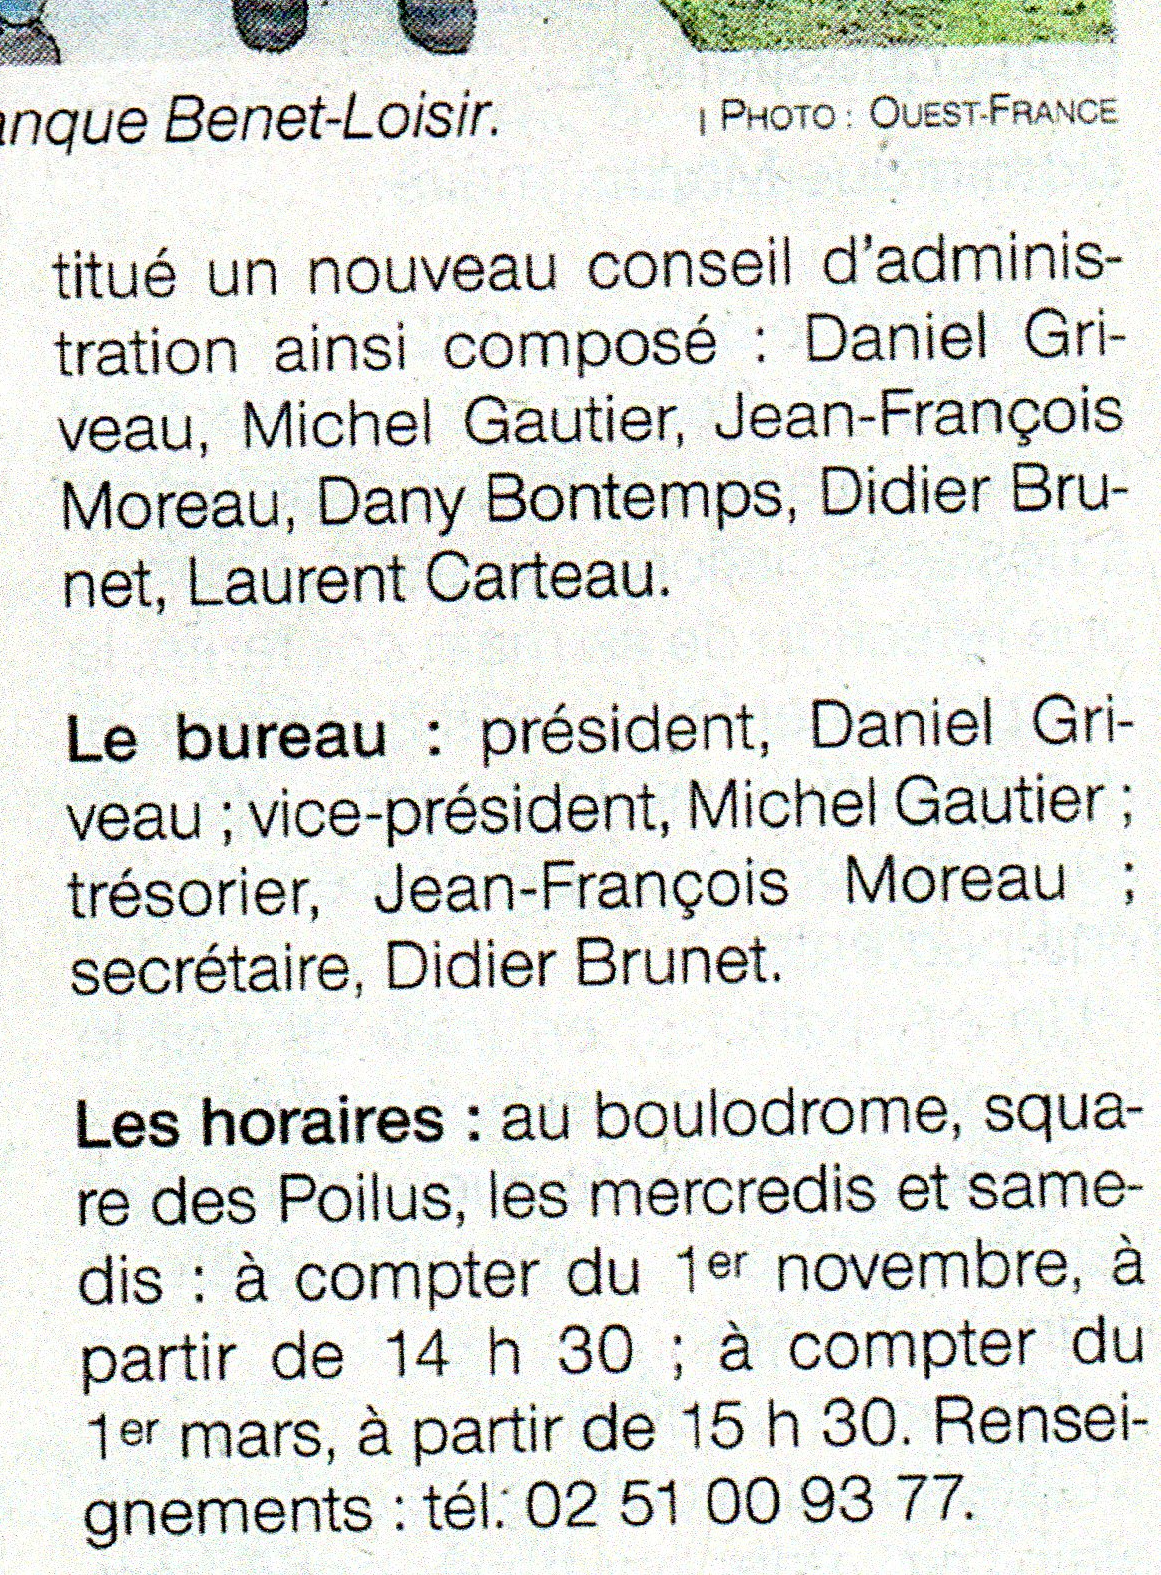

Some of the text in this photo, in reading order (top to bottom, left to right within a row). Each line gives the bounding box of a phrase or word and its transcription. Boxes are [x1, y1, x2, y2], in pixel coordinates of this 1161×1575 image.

[164, 89, 498, 144] Benet-Loisir.
[721, 92, 1120, 131] PHOTO OUEST-FRANCE
[52, 236, 791, 300] titué nouveau conseil
[54, 306, 1125, 379] tration ainsi composé Daniel Gri-
[58, 384, 1123, 458] veau, Michel Gautier, Jean-François
[62, 461, 1128, 537] Moreau, Dany Bontemps, Didier Bru-
[64, 549, 670, 615] net, Laurent Carteau.
[67, 692, 1134, 768] Le bureau président, Daniel Gri-
[66, 773, 1105, 848] veau vice-président, Michel Gautier
[67, 853, 1065, 921] trésorier, Jean-François Moreau
[71, 936, 781, 997] secrétaire, Didier Brunet.
[76, 1086, 1143, 1150] Les horaires boulodrome, squa-
[151, 1163, 1143, 1227] des Poilus, mercredis same-
[295, 1251, 540, 1311] compter
[778, 1238, 1081, 1293] novembre,
[82, 1320, 1036, 1396] partir 14 30 compter
[181, 1419, 335, 1464] mars,
[414, 1403, 563, 1467] partir
[683, 1400, 745, 1450] 15
[822, 1396, 910, 1448] 30.
[935, 1392, 1148, 1445] Rensei-
[83, 1473, 974, 1551] gnements tél. 02 51 00 93 77.
